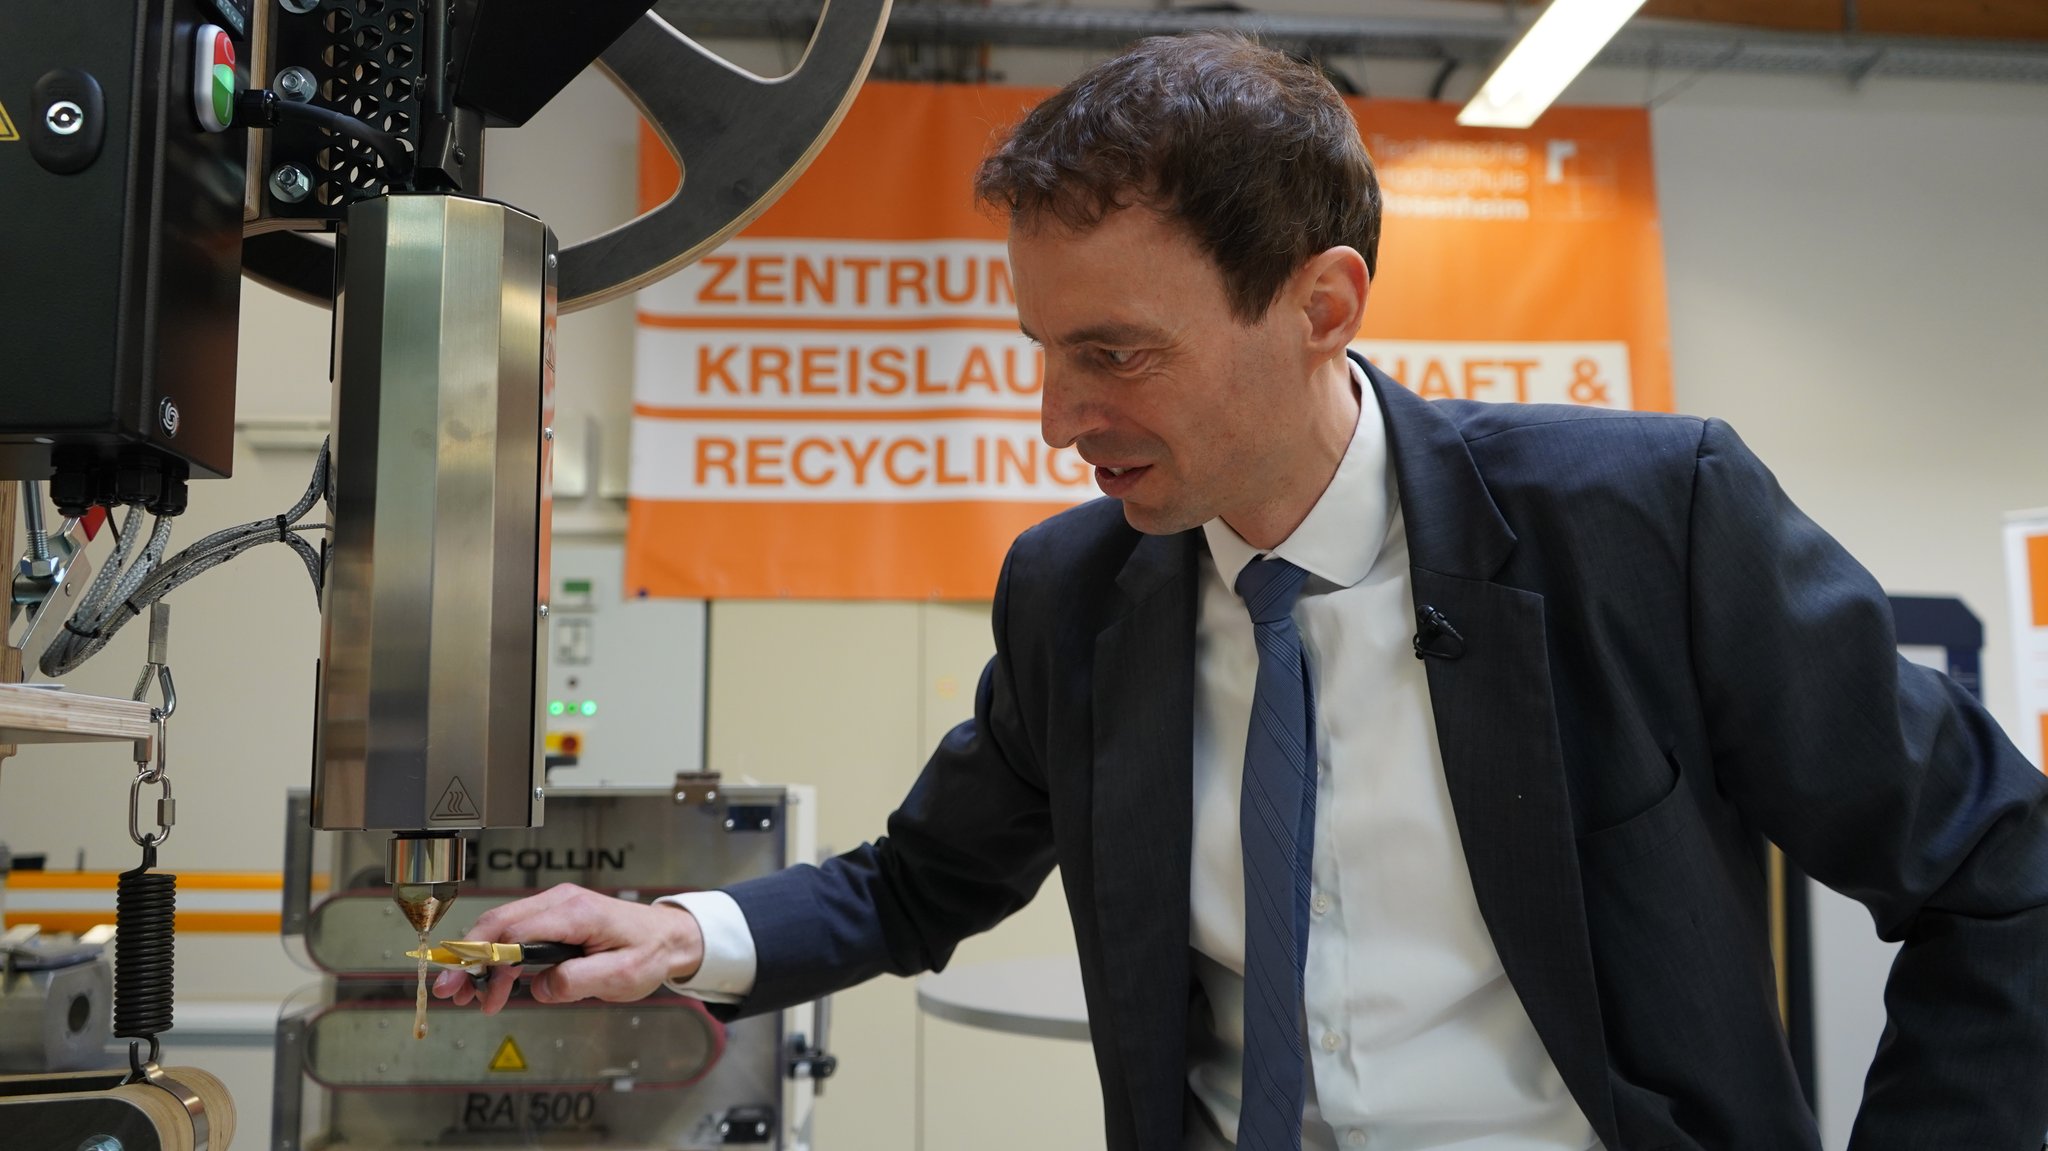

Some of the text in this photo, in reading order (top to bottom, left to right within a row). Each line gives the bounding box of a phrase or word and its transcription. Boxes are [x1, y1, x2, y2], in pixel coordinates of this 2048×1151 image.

[1568, 357, 1611, 405] &
[692, 436, 1091, 487] RECYCLING
[487, 848, 625, 871] COLLIN
[463, 1090, 596, 1125] RA 500
